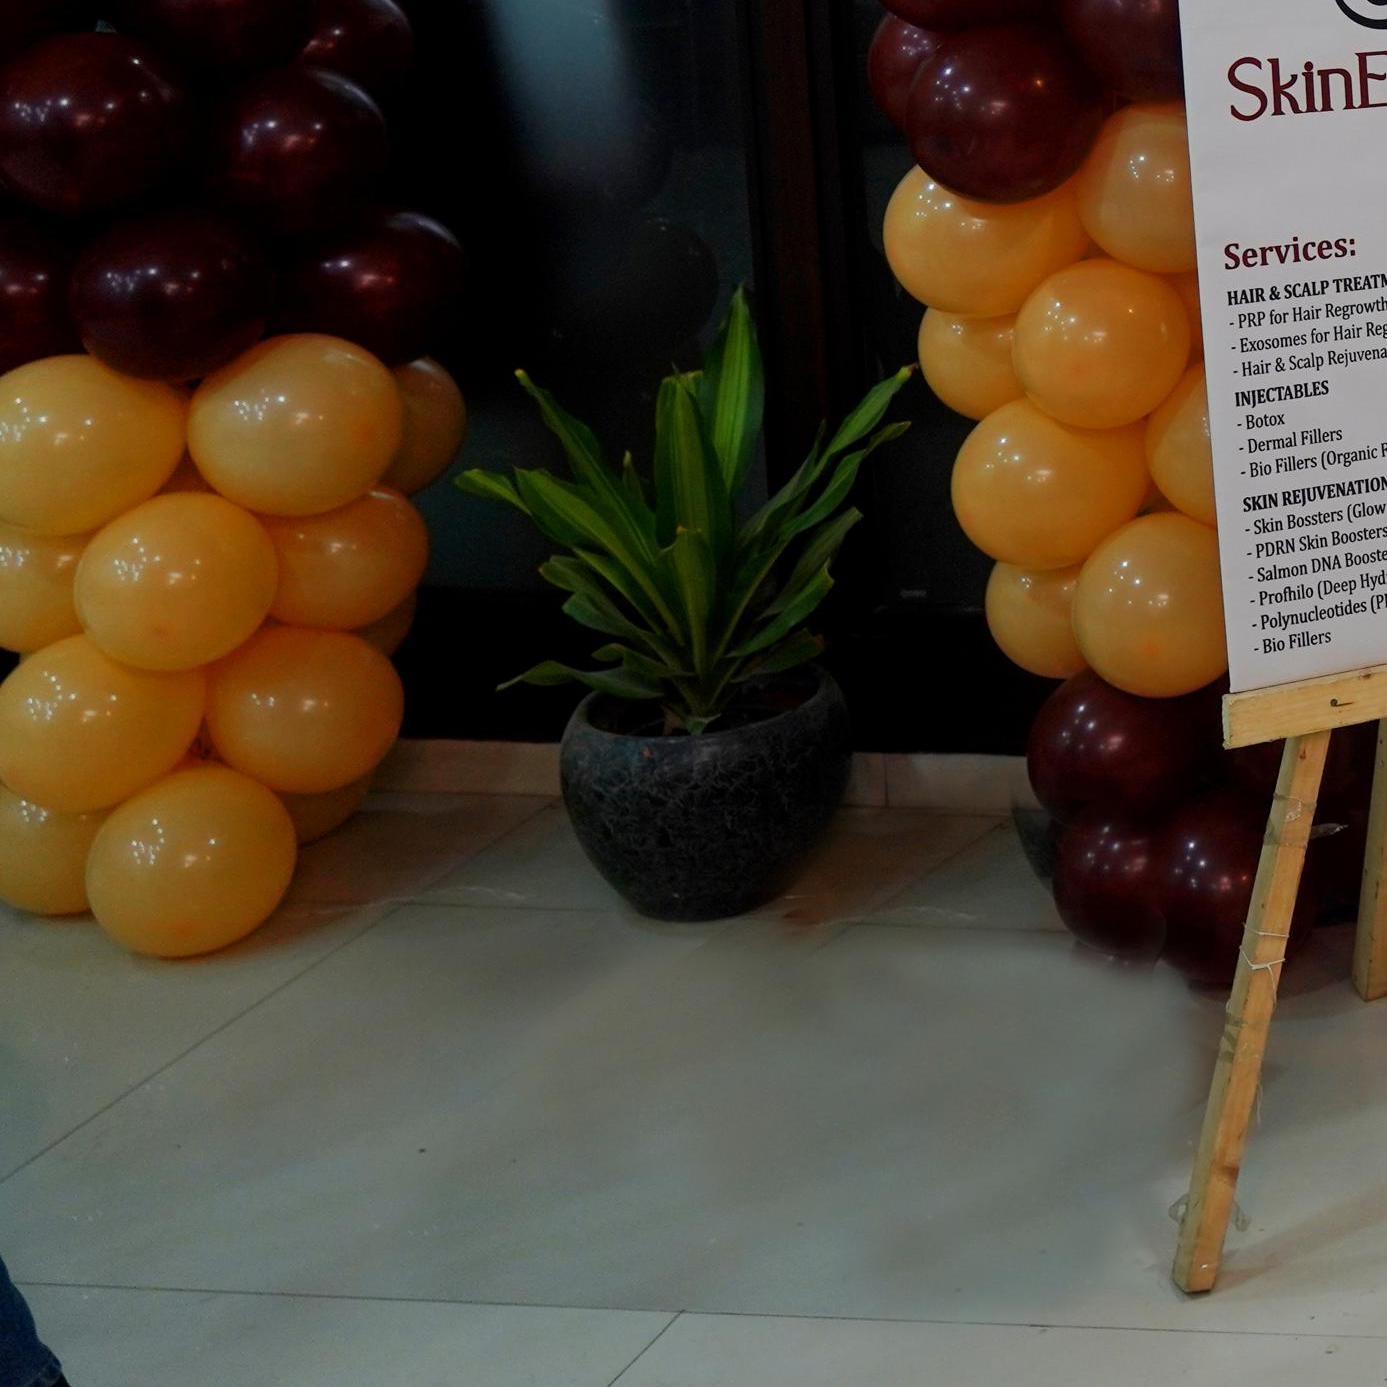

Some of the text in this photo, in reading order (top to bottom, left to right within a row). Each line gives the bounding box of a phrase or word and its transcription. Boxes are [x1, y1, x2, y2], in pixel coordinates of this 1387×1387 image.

[1224, 237, 1356, 269] Services:
[1226, 288, 1266, 305] HAIR
[1268, 286, 1281, 300] &
[1283, 281, 1329, 298] SCALP
[1238, 312, 1266, 328] PRP
[1269, 310, 1289, 324] for
[1292, 306, 1322, 321] Hair
[1239, 334, 1307, 352] Exosomes
[1310, 328, 1330, 343] for
[1333, 324, 1363, 340] Hair
[1241, 360, 1272, 376] Hair
[1274, 358, 1286, 372] &
[1288, 353, 1324, 370] Scalp
[1234, 380, 1329, 408] INJECTABLES
[1245, 414, 1285, 429] Botox
[1247, 428, 1343, 453] Dermal Fillers
[1249, 462, 1272, 477] Bio
[1275, 456, 1317, 473] Fillers
[1320, 446, 1378, 469] (Organic
[1242, 493, 1278, 511] SKIN
[1253, 518, 1284, 534] Skin
[1286, 510, 1343, 529] Bossters
[1346, 502, 1386, 522] (Glow
[1255, 538, 1295, 558] PDRN
[1298, 535, 1328, 551] Skin
[1257, 565, 1308, 581] Salmon
[1310, 555, 1342, 572] DNA
[1258, 584, 1314, 605] Profhilo
[1317, 580, 1357, 599] (Deep
[1260, 600, 1367, 630] Polynucleotides
[1262, 631, 1331, 653] Bio Fillers
